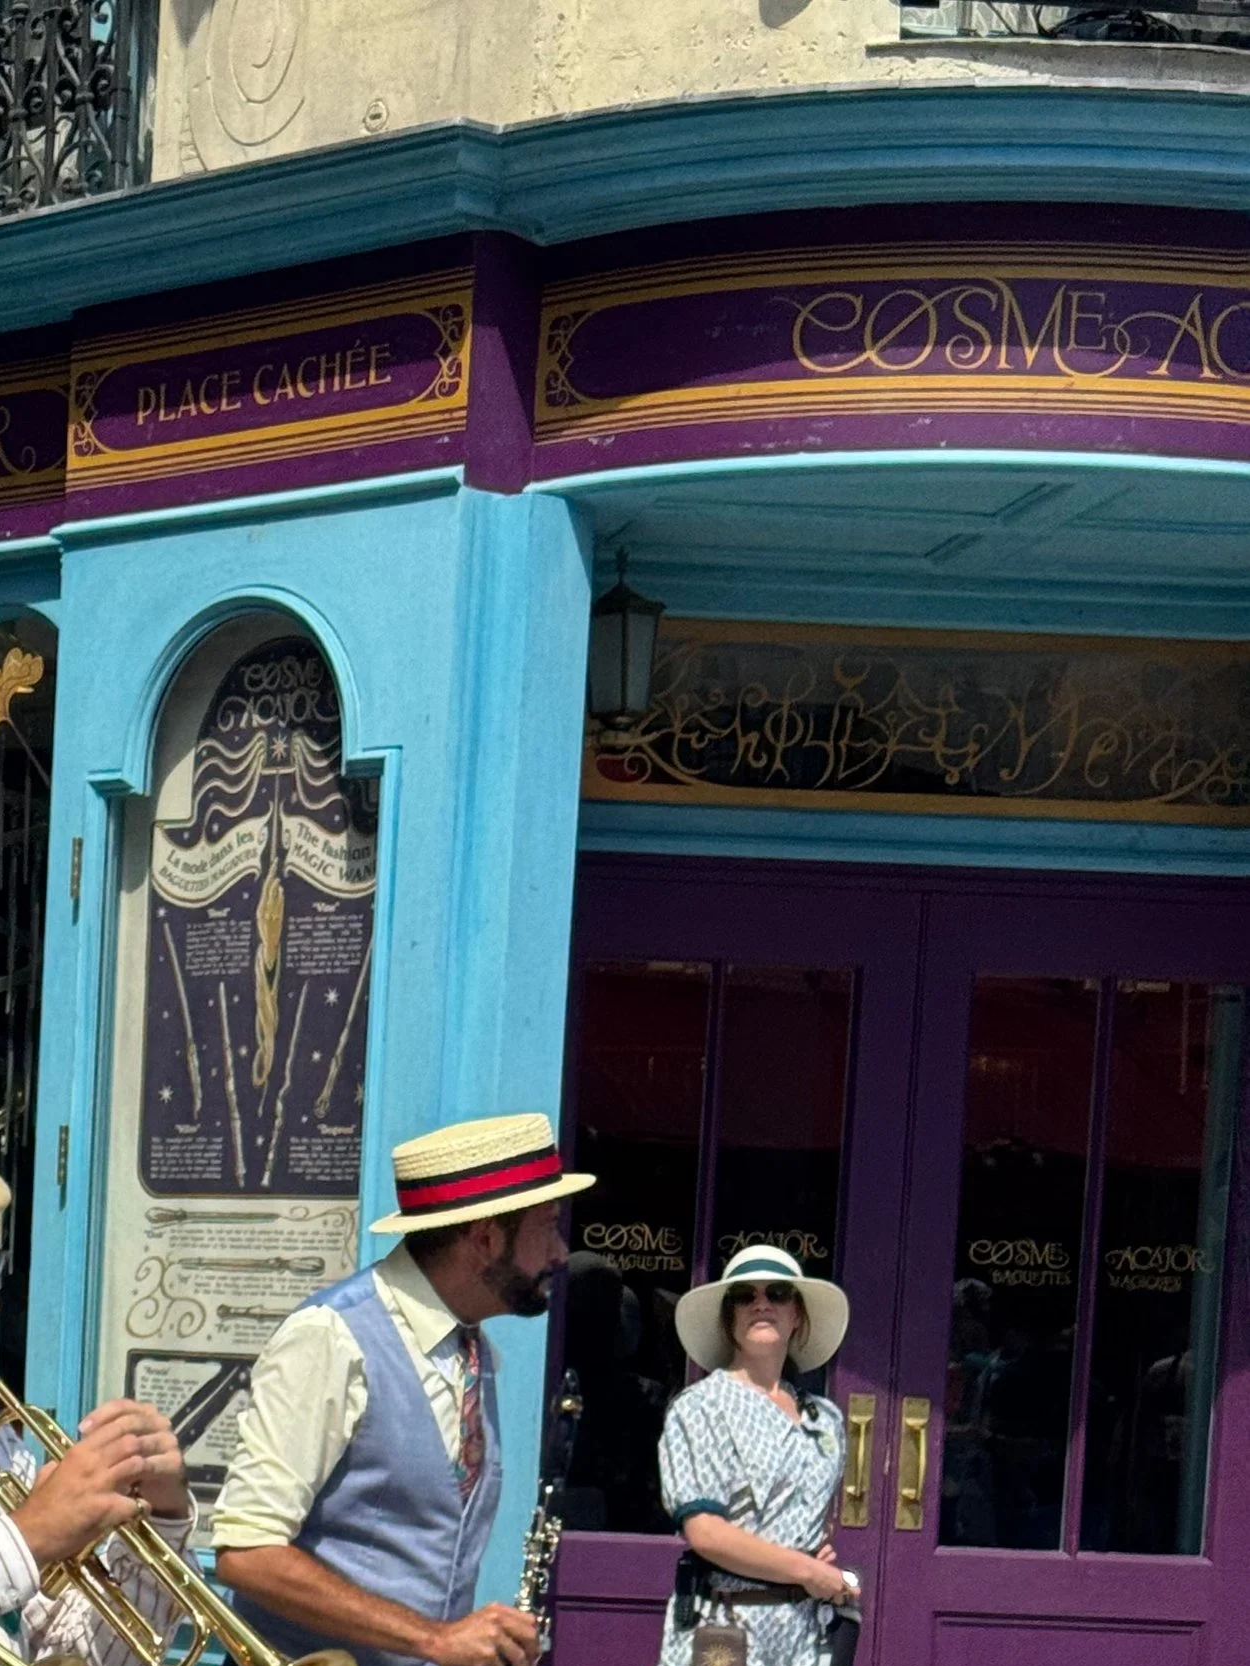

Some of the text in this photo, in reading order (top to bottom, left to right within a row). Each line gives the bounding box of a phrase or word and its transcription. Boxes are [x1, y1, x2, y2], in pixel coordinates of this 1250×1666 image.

[136, 339, 392, 426] PLACE CACHÉE
[166, 831, 255, 876] La mode dans les
[291, 842, 335, 878] MAGIC
[296, 823, 371, 861] The fashion
[1104, 1243, 1215, 1274] ACAJOR
